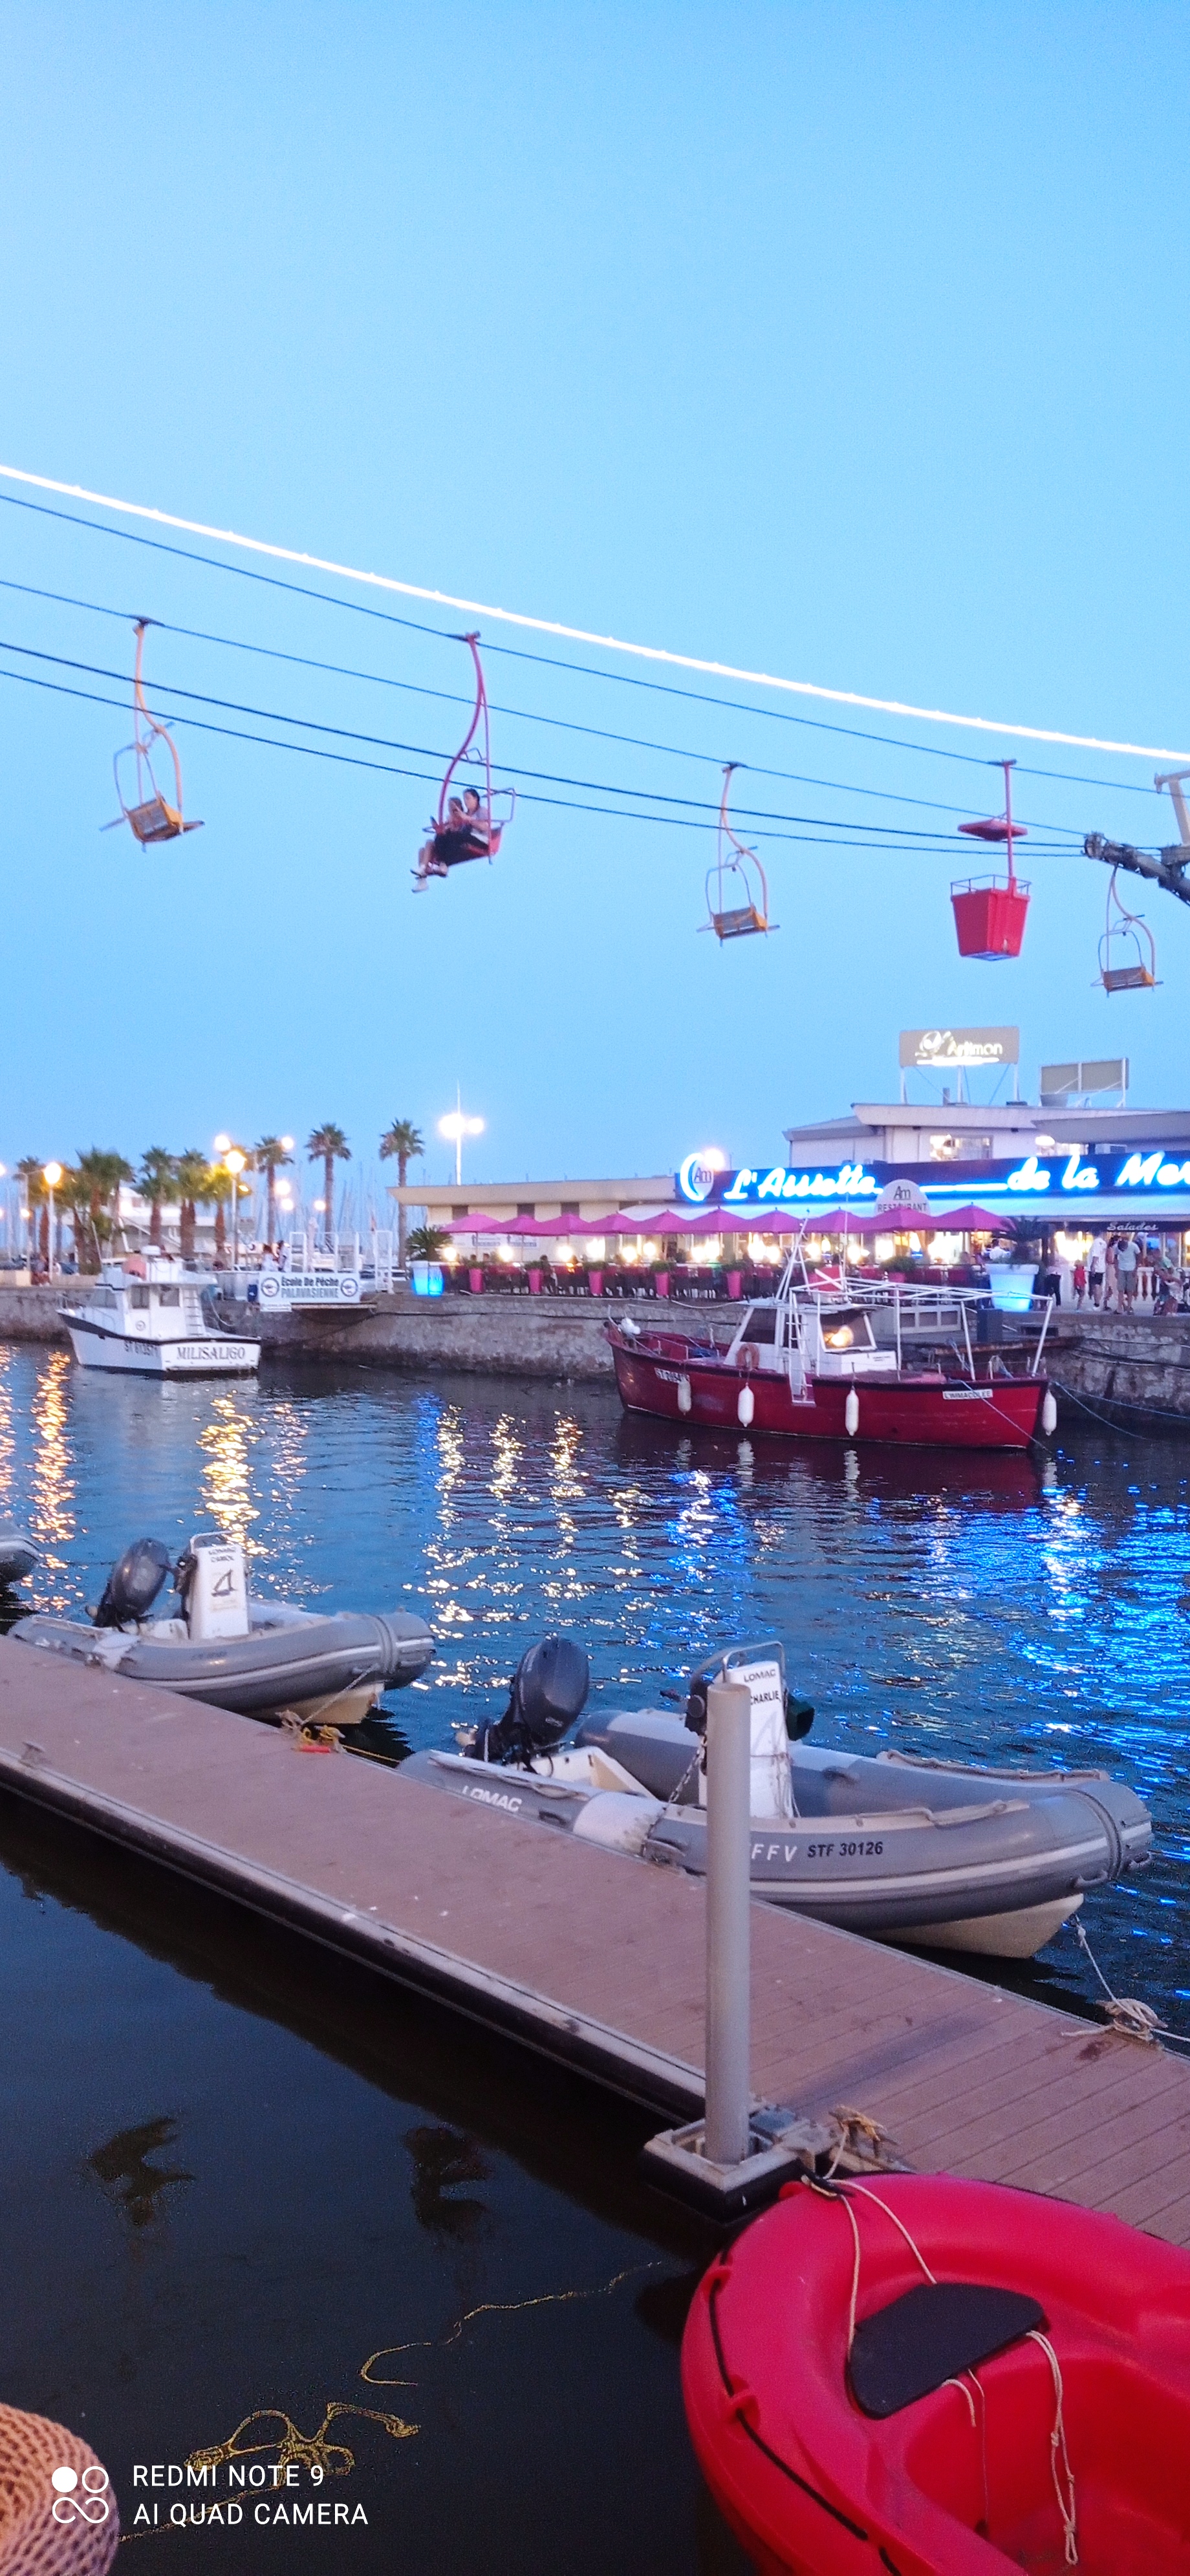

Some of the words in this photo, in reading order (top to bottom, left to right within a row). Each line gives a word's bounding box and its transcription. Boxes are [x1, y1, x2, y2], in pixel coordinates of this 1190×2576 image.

[1007, 1156, 1050, 1190] de
[1062, 1152, 1099, 1189] la
[1107, 1221, 1158, 1230] Salades
[304, 1277, 314, 1287] De
[177, 1347, 245, 1360] MILISALIGO
[744, 1669, 775, 1682] LOMAC
[808, 1844, 834, 1858] STF
[839, 1841, 883, 1856] 30126
